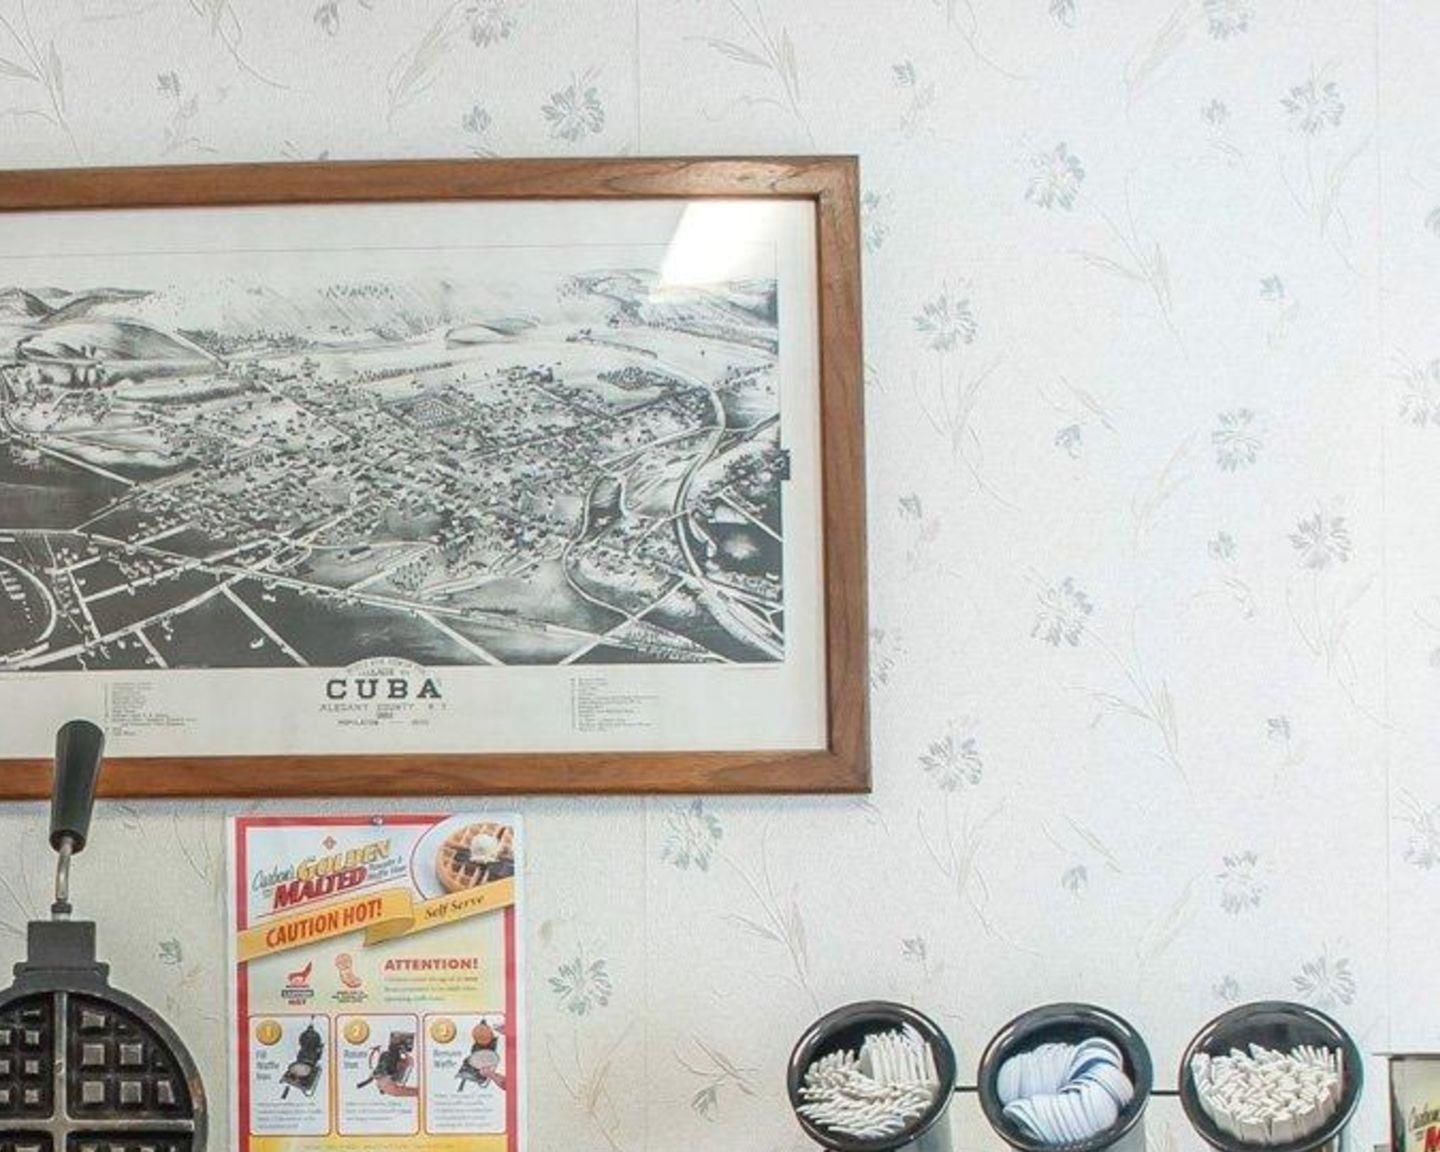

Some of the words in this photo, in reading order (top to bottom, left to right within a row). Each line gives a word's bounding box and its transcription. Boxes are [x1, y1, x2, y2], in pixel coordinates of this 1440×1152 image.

[326, 678, 442, 699] CUBA
[296, 839, 390, 881] GOLDEN
[273, 866, 368, 909] MALTED
[266, 909, 338, 948] CAUTION
[342, 898, 383, 926] HOT!
[424, 904, 448, 919] Self
[451, 895, 485, 912] Serve
[384, 958, 479, 971] ATTENTION!
